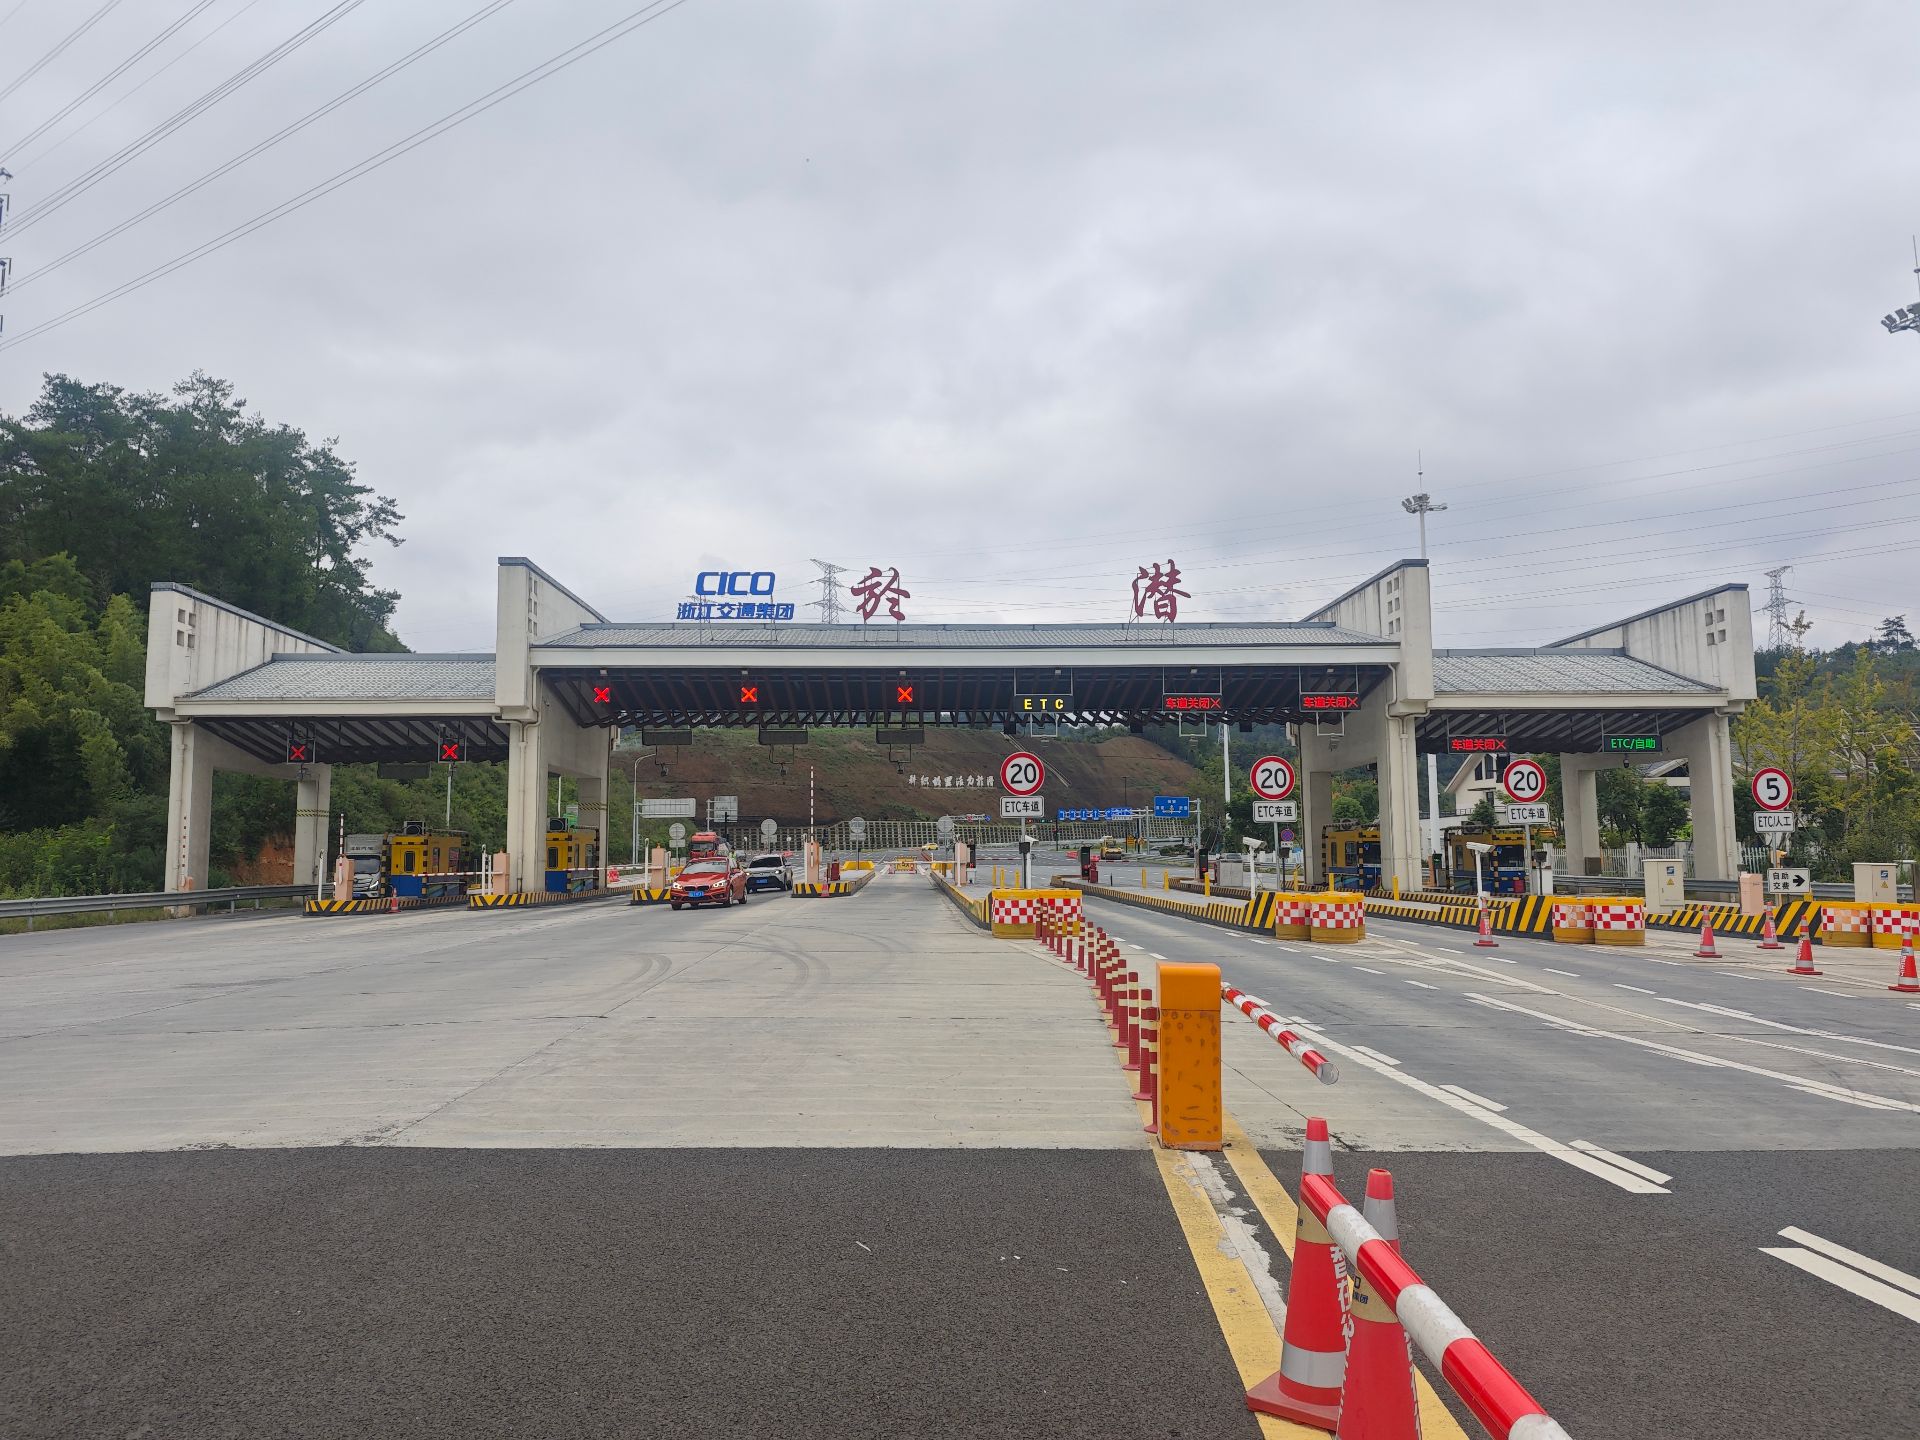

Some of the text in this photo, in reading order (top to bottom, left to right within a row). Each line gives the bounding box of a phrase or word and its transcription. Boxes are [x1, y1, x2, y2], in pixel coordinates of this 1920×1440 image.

[695, 571, 776, 596] CICO
[676, 602, 795, 621] 浙江交通集团
[1610, 737, 1656, 750] ETC/自助
[1010, 763, 1037, 785] 20
[1260, 767, 1287, 789] 20
[1513, 770, 1539, 791] 20
[1766, 777, 1781, 801] 5
[1005, 801, 1041, 813] ETC车道
[1257, 805, 1293, 818] ETC车道
[1510, 807, 1546, 820] ETC车道
[1757, 816, 1792, 828] ETC/人工
[1772, 872, 1789, 880] 自助
[1773, 882, 1790, 890] 交费
